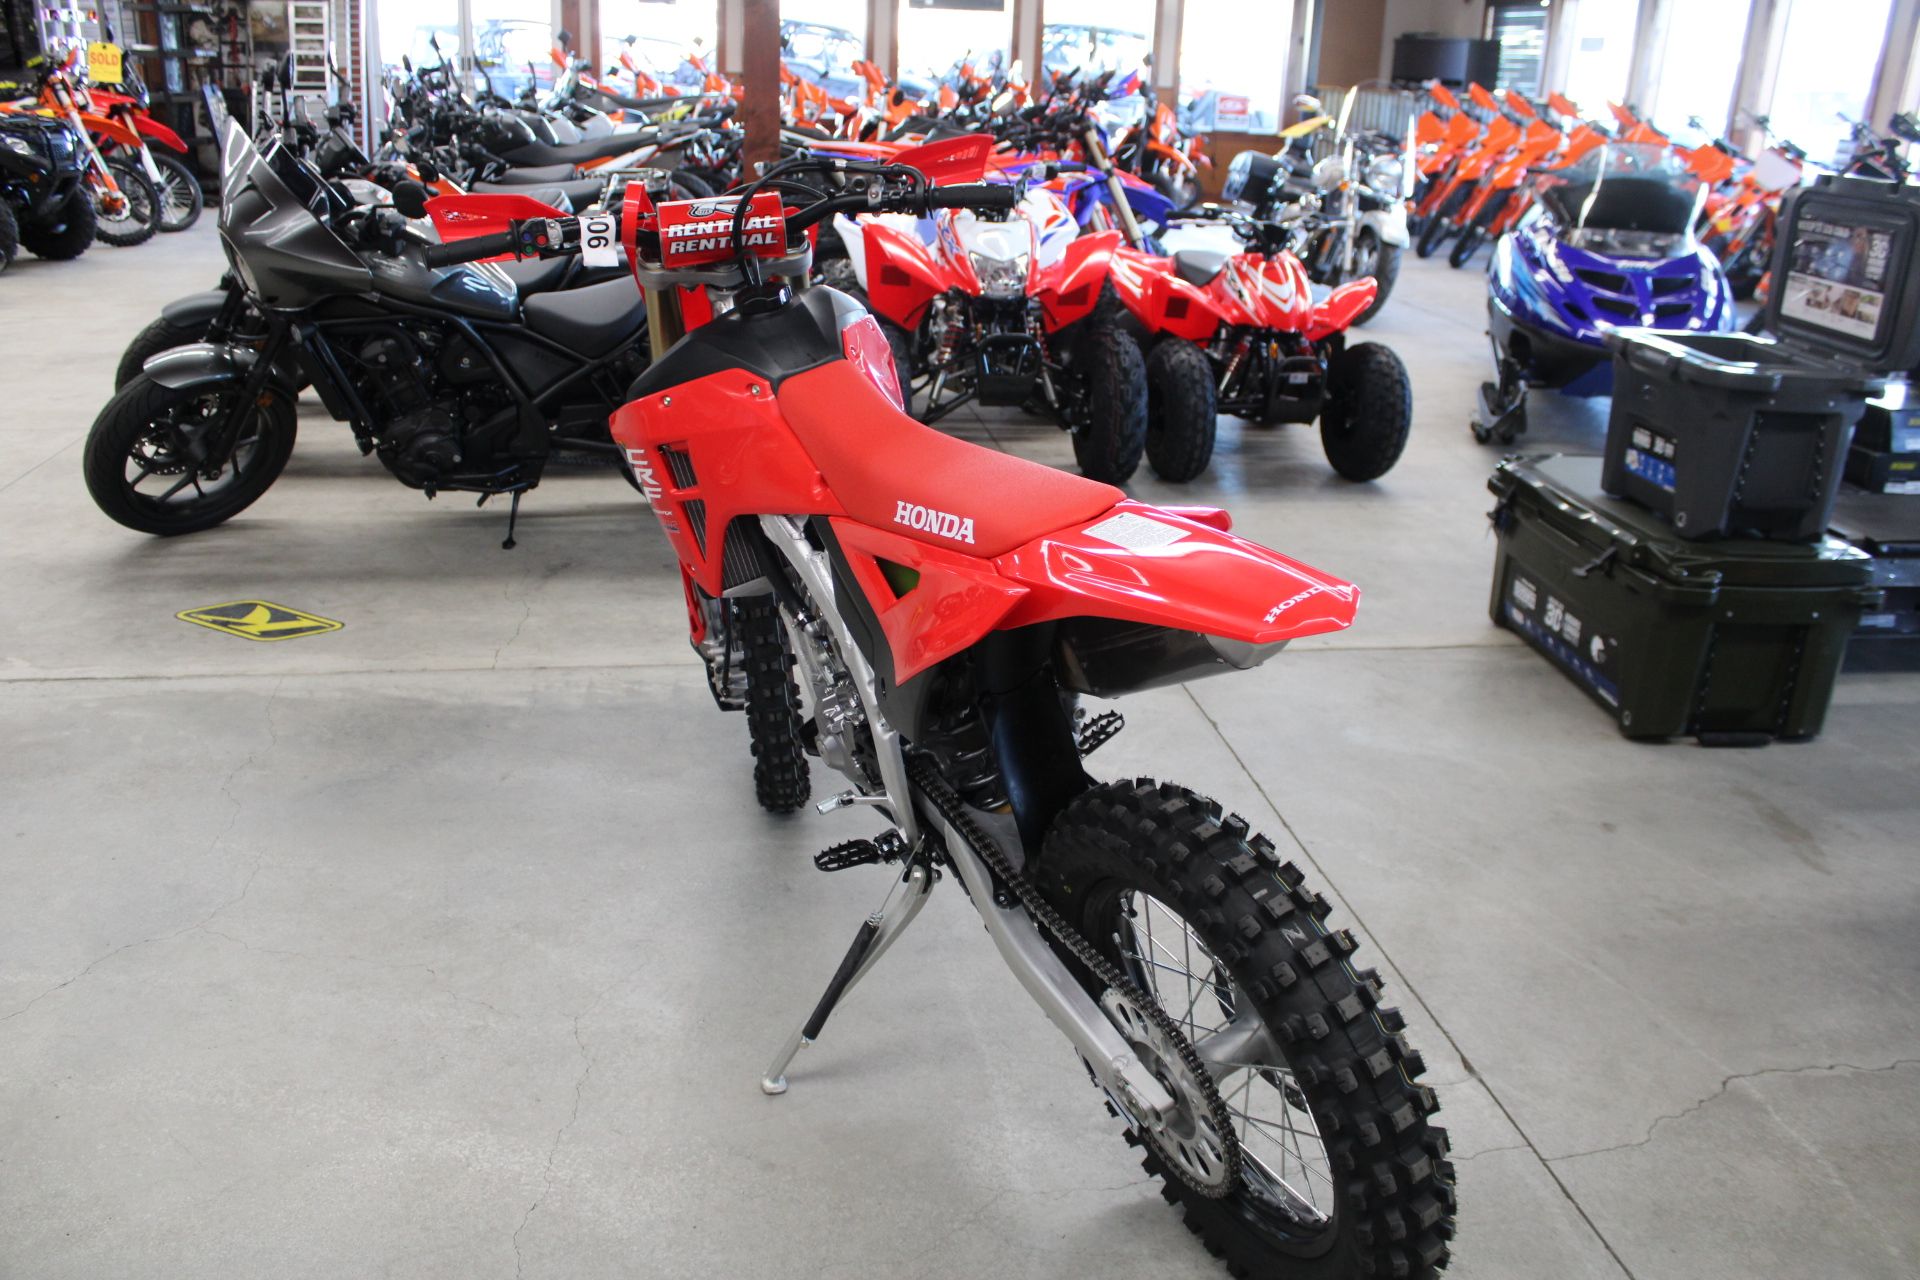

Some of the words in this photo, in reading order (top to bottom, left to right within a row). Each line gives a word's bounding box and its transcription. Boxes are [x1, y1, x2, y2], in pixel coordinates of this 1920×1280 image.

[90, 52, 119, 66] SOLD
[585, 216, 610, 249] 06
[626, 449, 662, 503] CRF
[893, 500, 975, 545] HONDA
